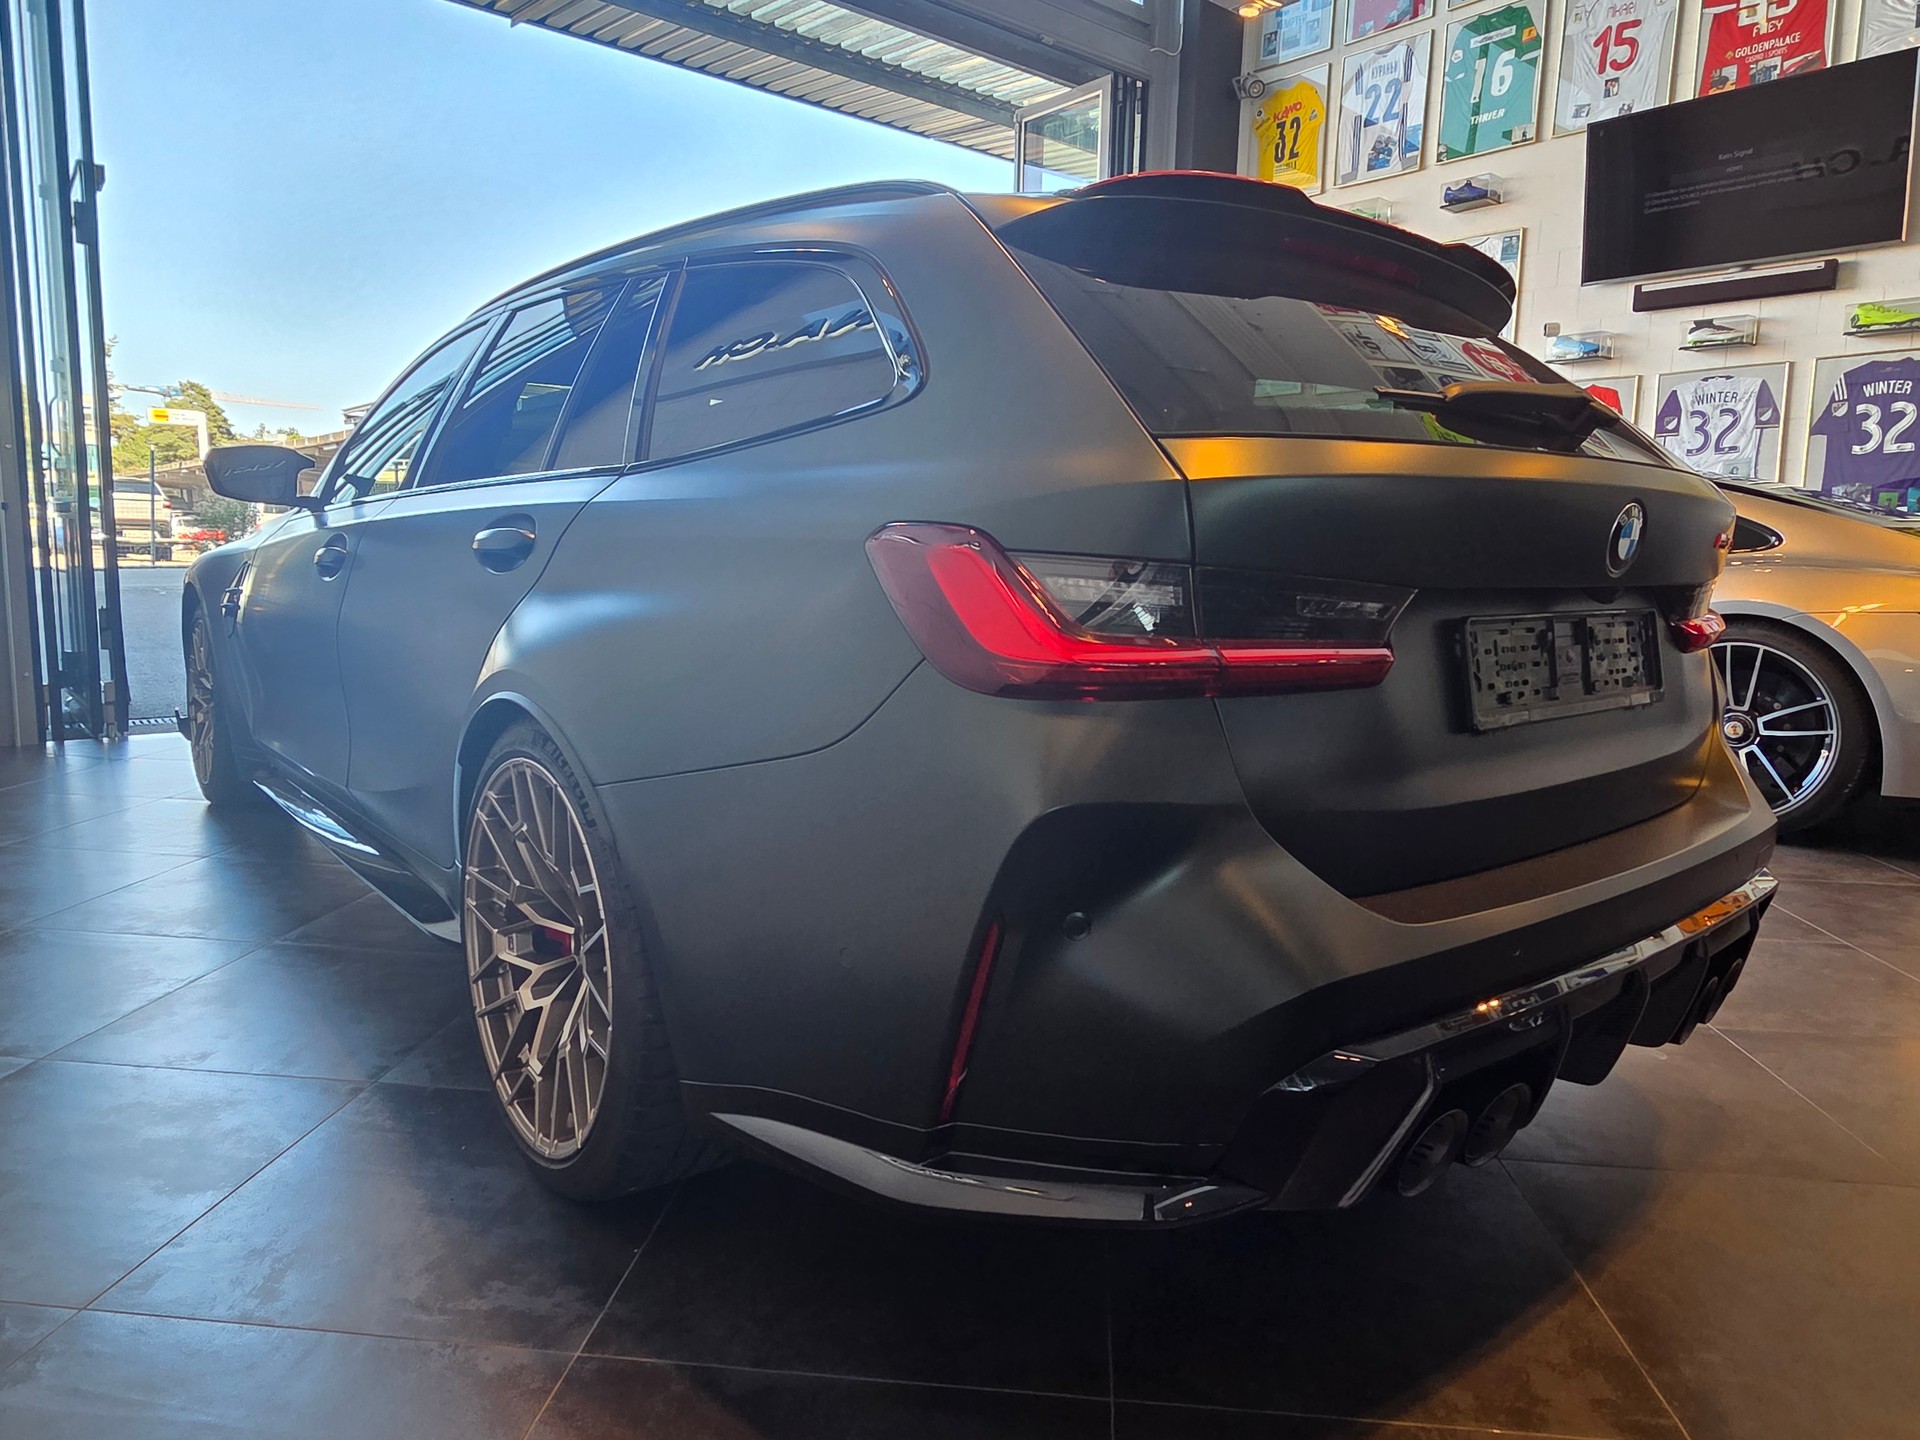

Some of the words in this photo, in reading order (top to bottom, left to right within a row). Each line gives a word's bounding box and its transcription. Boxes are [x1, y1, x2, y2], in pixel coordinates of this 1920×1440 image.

[1592, 19, 1643, 75] 15
[1735, 31, 1801, 58] GOLDENPALACE
[1470, 48, 1516, 104] 16
[1363, 78, 1402, 128] 22
[1470, 108, 1505, 125] THRIER
[1274, 116, 1301, 164] 32
[1718, 152, 1733, 161] Kein
[1733, 147, 1754, 159] Signal
[1695, 391, 1739, 406] WINTER
[1862, 380, 1912, 398] WINTER
[1686, 407, 1741, 457] 32
[1851, 401, 1917, 455] 32
[542, 739, 597, 829] MICHELIN
